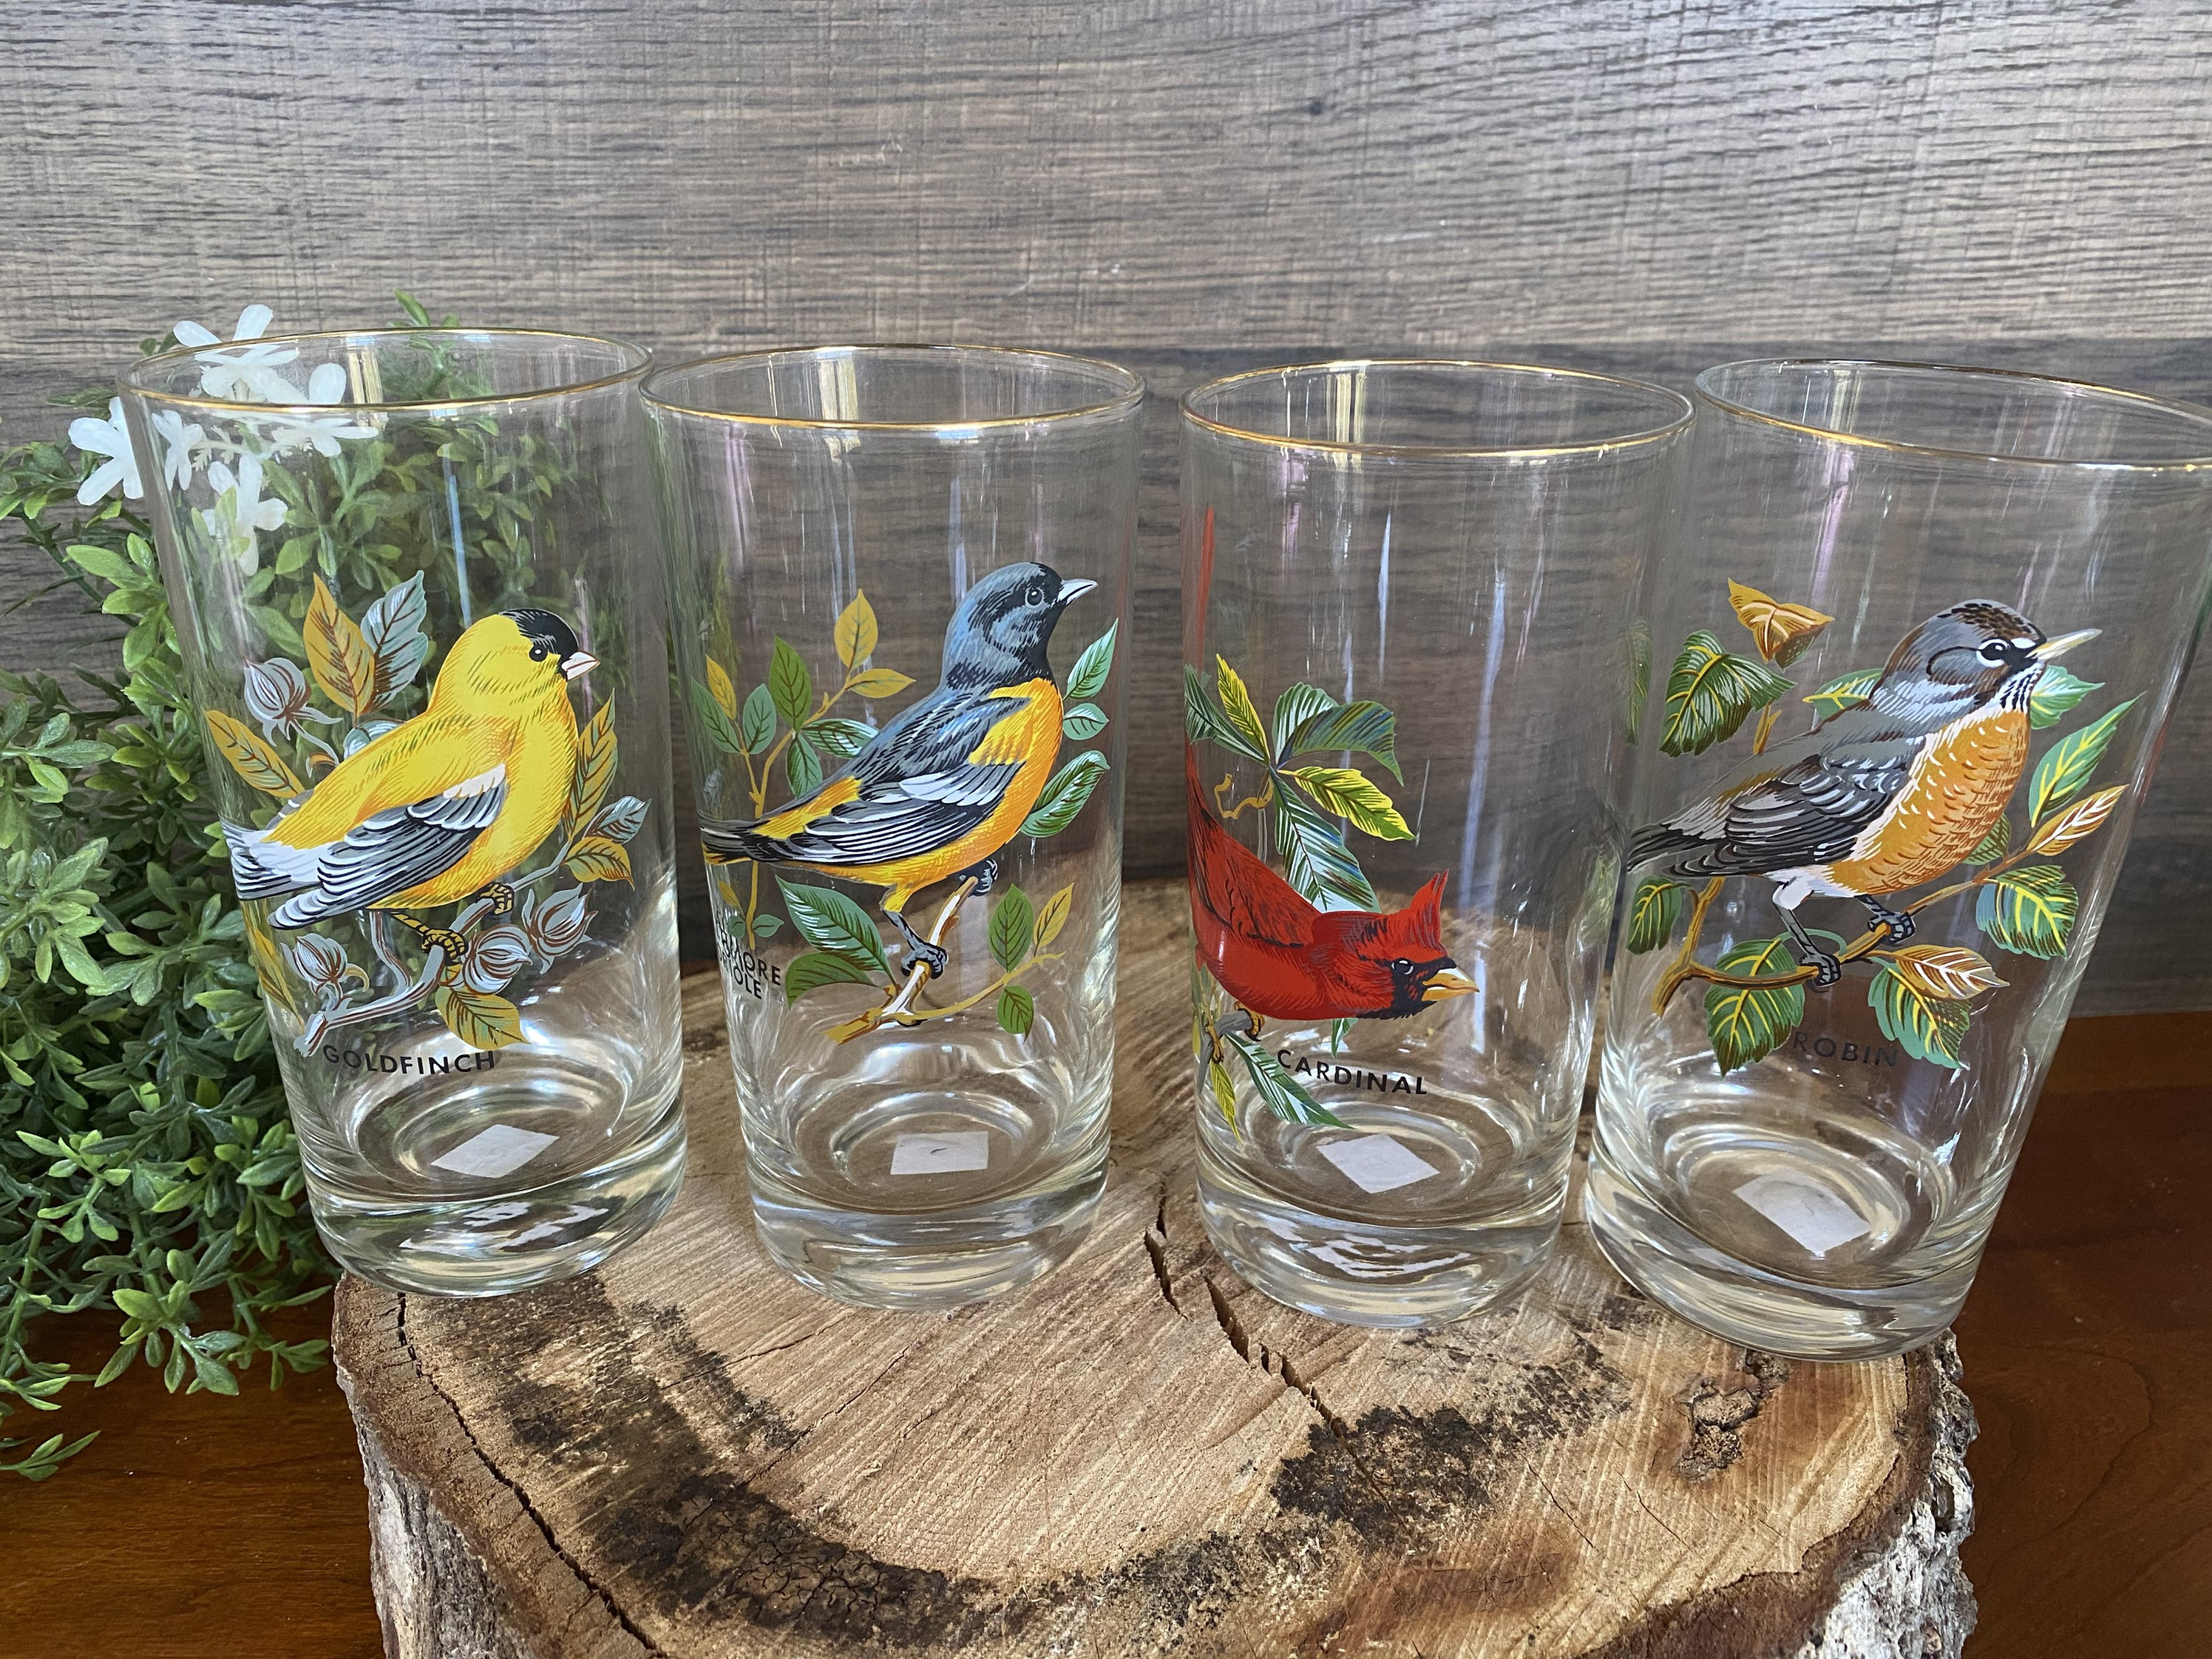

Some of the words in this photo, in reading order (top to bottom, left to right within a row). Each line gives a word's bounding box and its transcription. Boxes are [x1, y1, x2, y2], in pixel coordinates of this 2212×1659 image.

[322, 1044, 495, 1074] GOLDFINCH
[1793, 1031, 1899, 1067] ROBIN
[1277, 1049, 1428, 1095] CARDINAL
